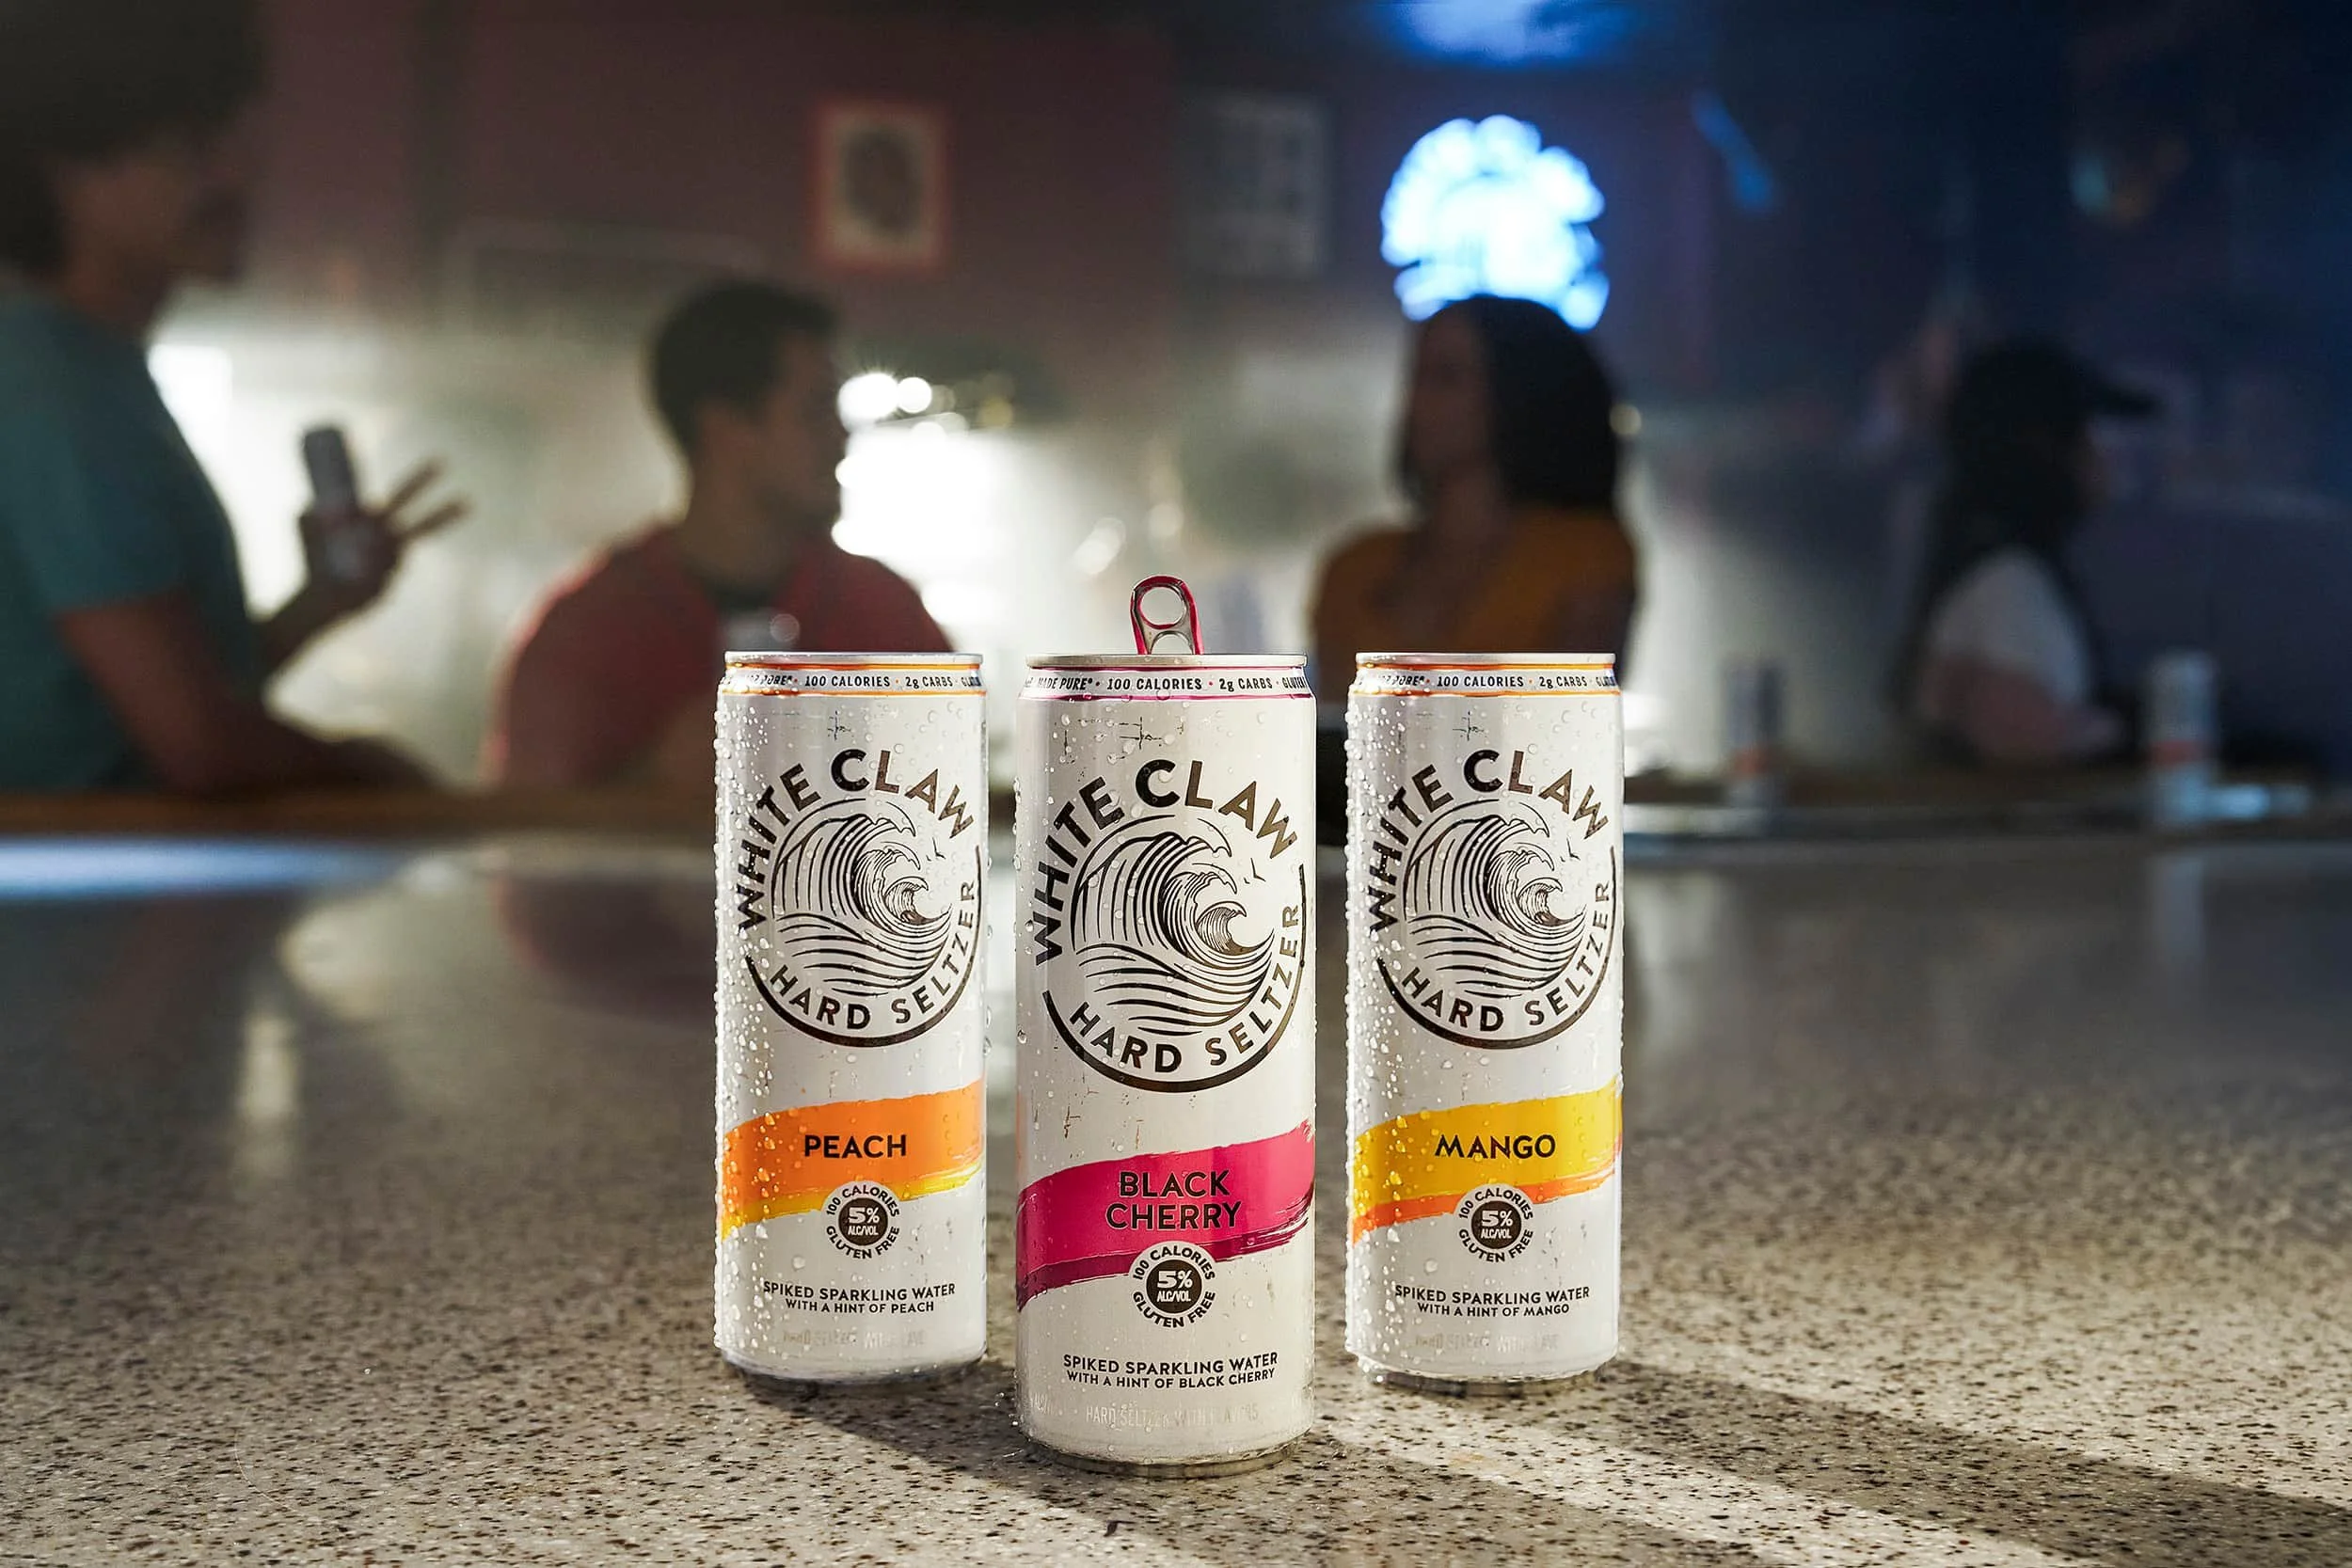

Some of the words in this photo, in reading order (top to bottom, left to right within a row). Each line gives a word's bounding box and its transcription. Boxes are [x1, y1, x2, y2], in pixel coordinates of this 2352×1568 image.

[804, 675, 827, 687] 100
[832, 675, 890, 687] CALORIES
[905, 676, 920, 689] 2g
[922, 676, 953, 687] CARBS
[1106, 678, 1131, 690] 100
[1136, 678, 1201, 690] CALORIES
[1219, 678, 1234, 692] 2g
[1238, 677, 1273, 689] CARBS
[1437, 675, 1459, 687] 100
[1464, 675, 1524, 688] CALORIES
[1539, 676, 1553, 689] 2g
[1556, 676, 1588, 687] CARBS
[737, 763, 821, 933] WHITE
[831, 749, 974, 839] CLAW
[1368, 764, 1454, 932] WHITE
[1463, 749, 1609, 840] CLAW
[1032, 777, 1125, 966] WHITE
[1136, 759, 1297, 859] CLAW
[770, 965, 871, 1029] HARD
[891, 880, 976, 1023] SELTZER
[1402, 967, 1504, 1031] HARD
[1525, 881, 1610, 1025] SELTZER
[1069, 1001, 1183, 1073] HARD
[1205, 905, 1299, 1066] SELTZER
[804, 1133, 907, 1159] PEACH
[1434, 1133, 1556, 1160] MANGO
[1119, 1169, 1231, 1197] BLACK
[826, 1196, 841, 1215] 100
[842, 1184, 900, 1216] CALORIES
[1458, 1200, 1474, 1219] 100
[1474, 1188, 1534, 1220] CALORIES
[849, 1207, 881, 1224] 5%
[1105, 1200, 1242, 1229] CHERRY
[1481, 1210, 1514, 1227] 5%
[826, 1226, 872, 1259] GLUTEN
[875, 1227, 900, 1255] FREE
[848, 1225, 879, 1236] ALC/VOL
[1481, 1228, 1512, 1240] ALC/VOL
[1459, 1228, 1505, 1262] GLUTEN
[1508, 1229, 1534, 1259] FREE
[1133, 1259, 1149, 1280] 100
[1150, 1245, 1216, 1279] CALORIES
[763, 1280, 814, 1298] SPIKED
[819, 1288, 908, 1302] SPARKLING
[912, 1283, 956, 1299] WATER
[1157, 1270, 1193, 1289] 5%
[785, 1298, 818, 1311] WITH
[821, 1302, 831, 1313] A
[834, 1303, 866, 1314] HINT
[868, 1304, 886, 1313] OF
[891, 1301, 934, 1314] PEACH
[1156, 1290, 1191, 1303] ALC/VOL
[1394, 1284, 1447, 1302] SPIKED
[1452, 1292, 1541, 1306] SPARKLING
[1546, 1286, 1590, 1303] WATER
[1133, 1291, 1184, 1328] GLUTEN
[1187, 1291, 1216, 1323] FREE
[1417, 1302, 1450, 1316] WITH
[1454, 1307, 1463, 1317] A
[1467, 1307, 1498, 1317] HINT
[1502, 1307, 1520, 1317] OF
[1523, 1304, 1570, 1317] MANGO
[1063, 1354, 1120, 1372] SPIKED
[1125, 1360, 1224, 1375] SPARKLING
[1229, 1352, 1279, 1370] WATER
[1067, 1370, 1099, 1385] WITH
[1103, 1376, 1112, 1386] A
[1116, 1377, 1150, 1388] HINT
[1154, 1378, 1175, 1388] OF
[1179, 1376, 1225, 1388] BLACK
[1228, 1368, 1276, 1386] CHERRY
[1085, 1405, 1117, 1424] HARD
